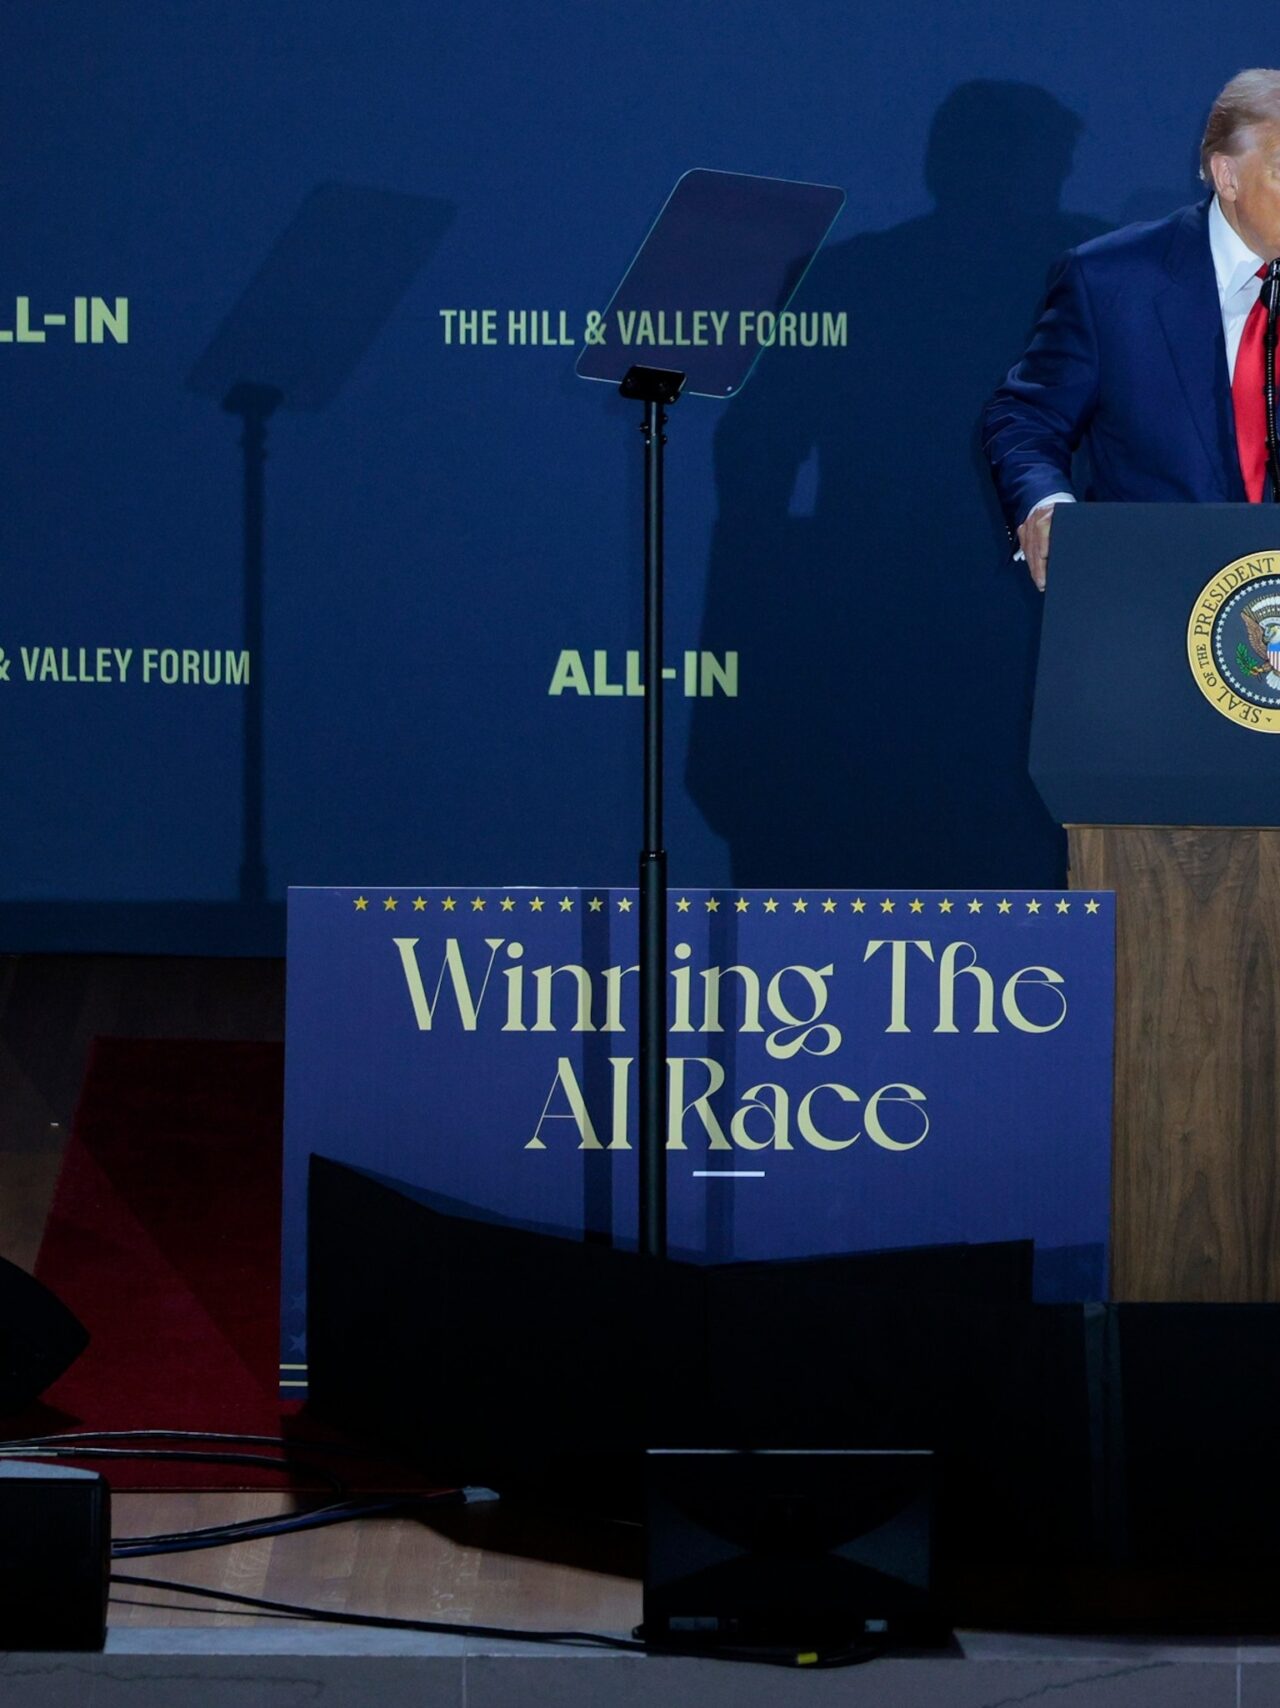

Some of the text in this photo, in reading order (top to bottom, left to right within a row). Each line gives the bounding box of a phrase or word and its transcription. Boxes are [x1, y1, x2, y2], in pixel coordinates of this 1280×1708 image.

[0, 296, 128, 344] L-IN
[440, 310, 848, 347] THE HILL & VALLEY FORUM
[1194, 558, 1275, 637] PRESIDENT
[20, 647, 133, 683] VALLEY
[143, 648, 250, 685] FORUM
[548, 649, 738, 697] ALL-IN
[1196, 644, 1209, 669] THE
[1203, 671, 1217, 687] OF
[1217, 685, 1262, 723] SEAL
[864, 940, 1067, 1034] The
[524, 1057, 930, 1151] AI Race
